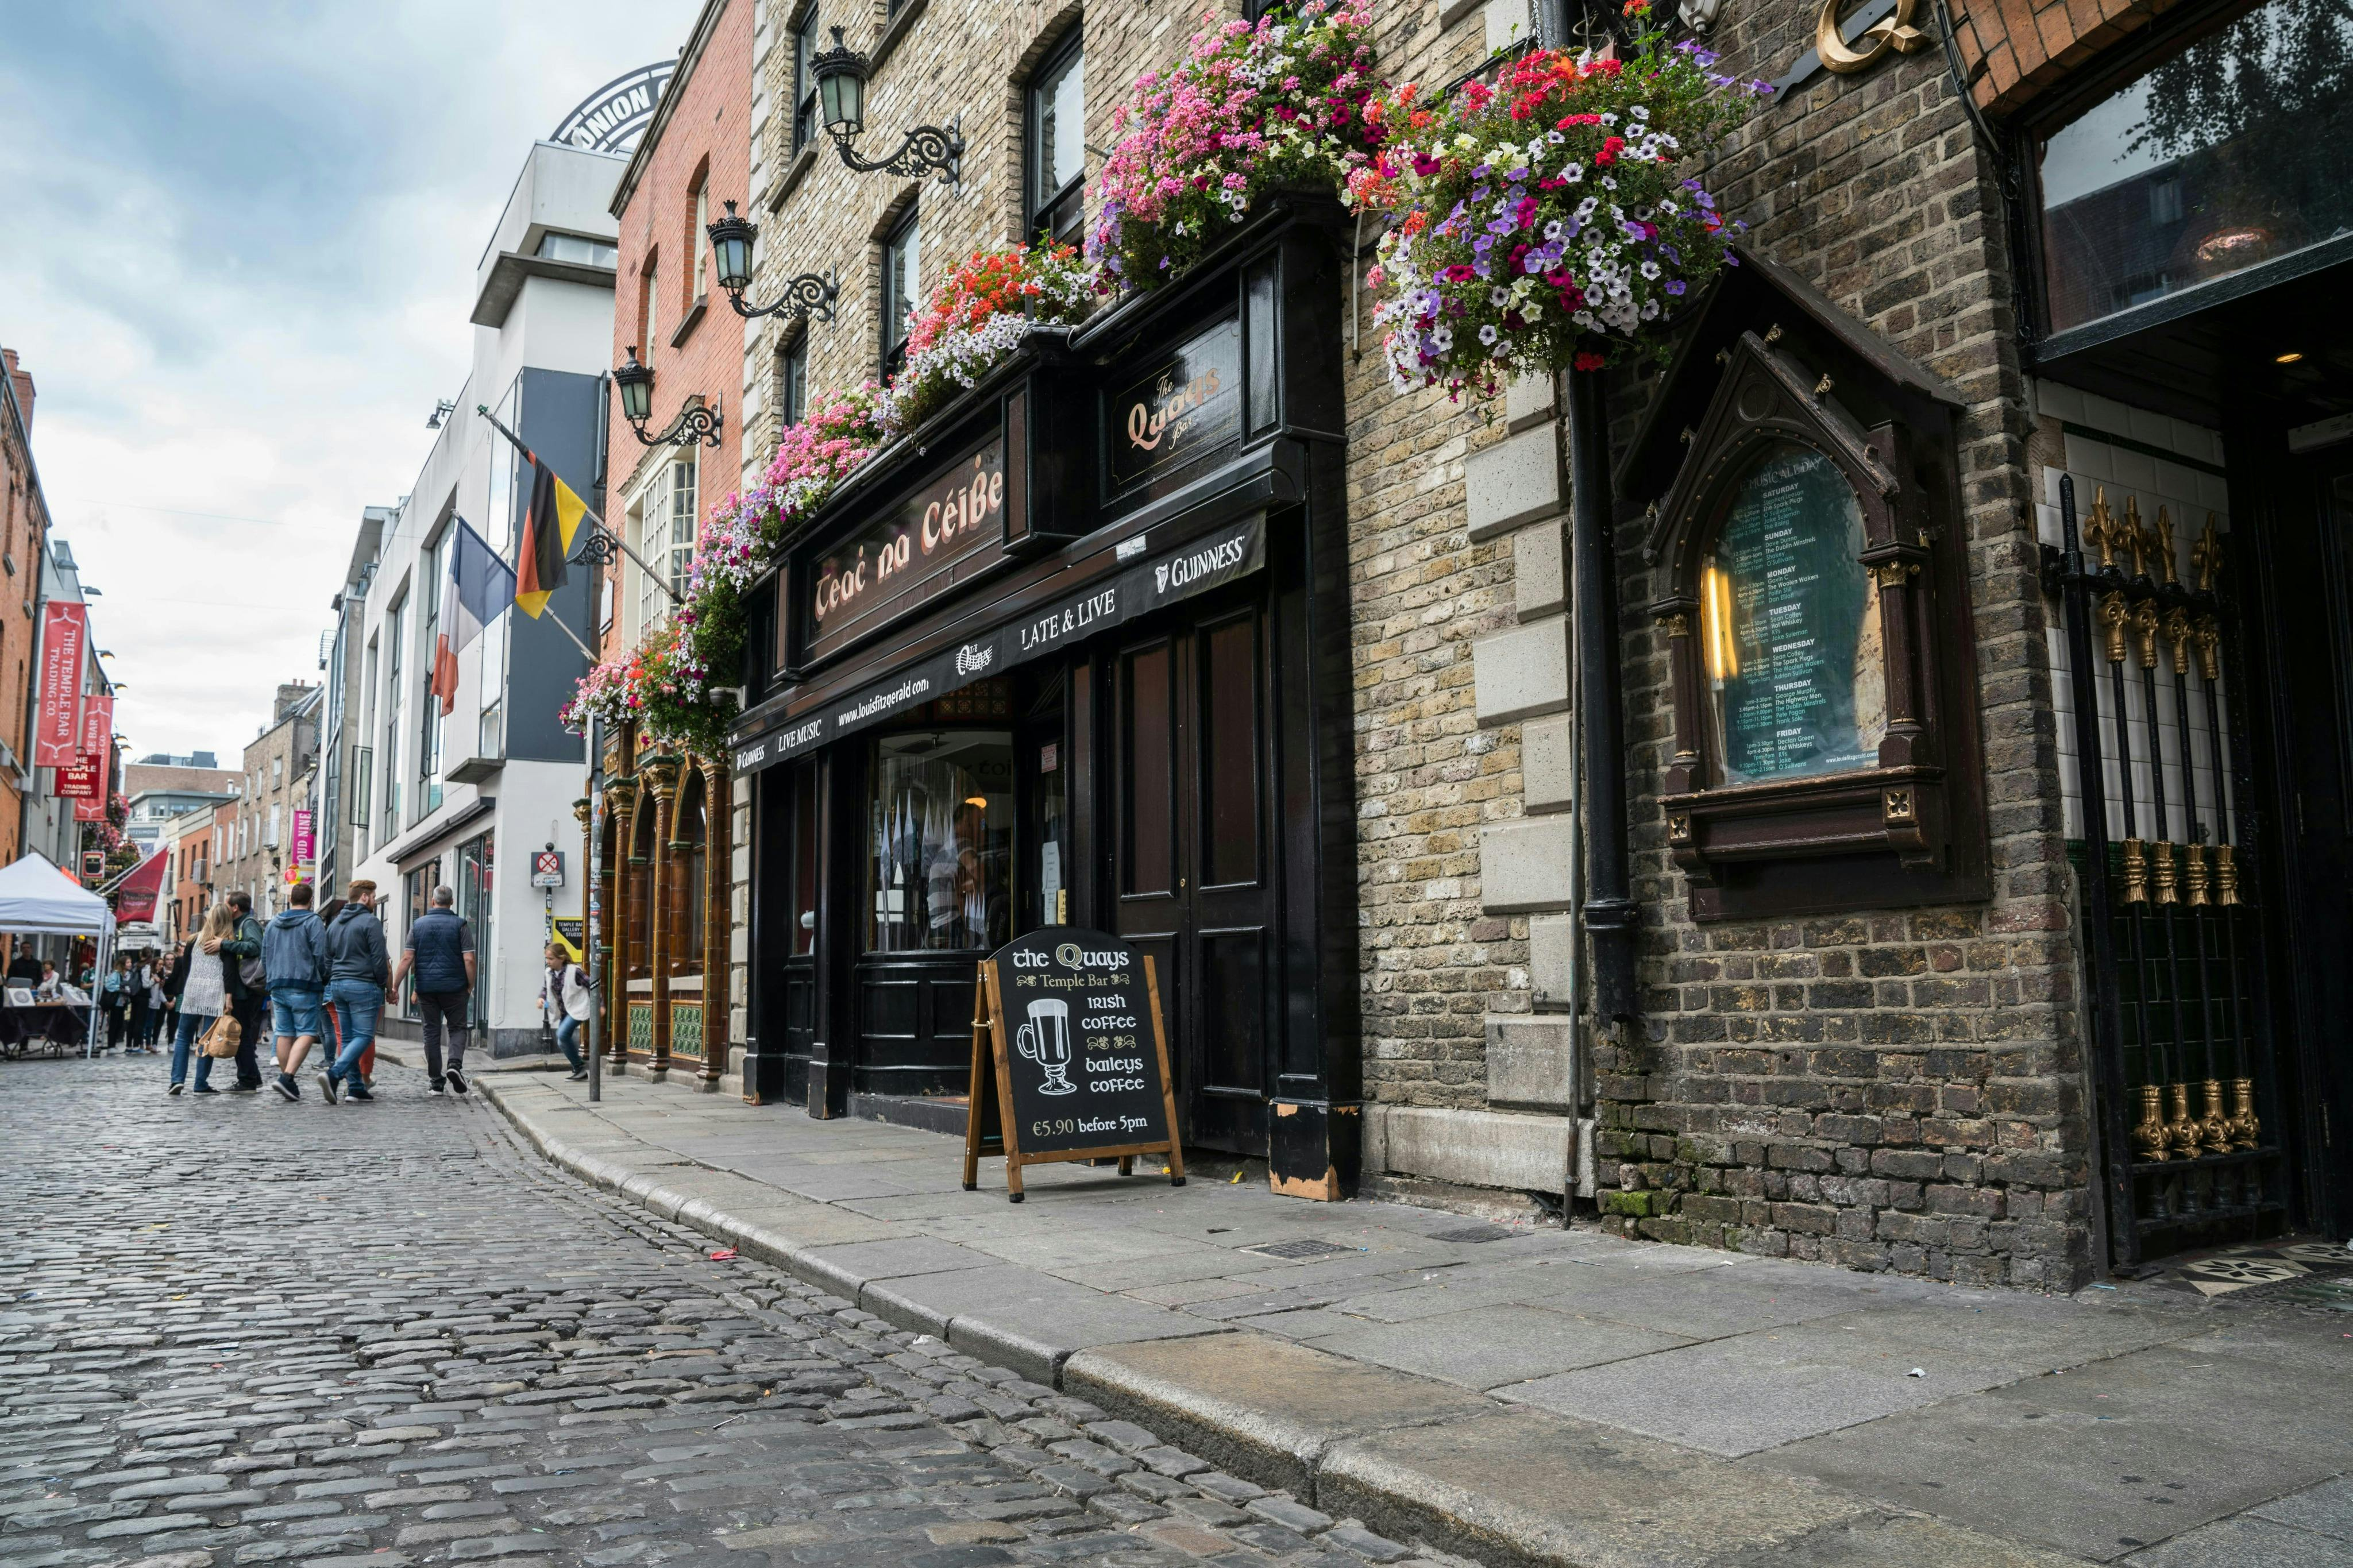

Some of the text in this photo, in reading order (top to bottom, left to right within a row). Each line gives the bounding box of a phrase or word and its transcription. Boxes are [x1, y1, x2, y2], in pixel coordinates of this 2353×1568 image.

[577, 85, 651, 149] UNION
[1154, 369, 1174, 406] The
[1128, 368, 1220, 450] Quays
[1168, 417, 1197, 450] Bar
[1749, 471, 1779, 489] MUSIC
[1781, 465, 1800, 479] ALL
[1801, 457, 1825, 472] DAY
[1762, 482, 1799, 499] SATURDAY
[1763, 495, 1784, 506] Stephen
[1773, 500, 1788, 510] Spark
[1789, 496, 1803, 505] Plugs
[1764, 516, 1776, 524] Jake
[1775, 519, 1789, 527] Rising
[1764, 528, 1792, 541] SUNDAY
[1780, 535, 1797, 544] Dunne
[1776, 542, 1792, 551] Dublin
[1793, 536, 1816, 547] Minstrels
[878, 534, 910, 584] na
[1171, 536, 1244, 588] GUINNESS
[1766, 551, 1785, 561] Shakey
[1767, 565, 1796, 578] MONDAY
[1768, 576, 1783, 584] Gavin
[1778, 579, 1798, 588] Woolen
[1799, 574, 1819, 583] Wakers
[1769, 603, 1802, 616] TUESDAY
[1021, 588, 1116, 651] LATE & LIVE
[1781, 617, 1803, 627] Whiskey
[1785, 628, 1808, 638] Suleman
[1772, 638, 1815, 653] WEDNESDAY
[1787, 650, 1804, 658] Coffey
[1783, 657, 1798, 666] Spark
[1783, 663, 1803, 671] Woolen
[1804, 659, 1824, 667] Wakers
[48, 647, 60, 699] TRADING
[1774, 671, 1791, 680] Adrian
[1792, 668, 1812, 677] Sullivan
[57, 629, 76, 737] THE TEMPLE BAR
[1775, 679, 1811, 692] THURSDAY
[1775, 691, 1795, 700] George
[1796, 687, 1816, 696] Murphy
[1785, 694, 1808, 704] Highway
[838, 678, 929, 727] www.louisfitzgeraldcom
[1785, 702, 1802, 710] Dublin
[1803, 698, 1826, 706] Minstrels
[1789, 709, 1806, 717] Fagan
[89, 720, 98, 738] BAR
[778, 719, 822, 752] LIVE MUSIC
[1777, 727, 1802, 737] FRIDAY
[1746, 740, 1774, 750] 1pm-3.30pm
[1777, 737, 1796, 746] Declan
[1747, 747, 1775, 756] 4pm-6.30pm
[1788, 741, 1812, 750] Whiskeys
[742, 745, 765, 768] GUINNESS
[1753, 753, 1775, 761] 7pm-9pm
[298, 813, 312, 837] NINE
[1056, 943, 1130, 971] Quays
[1039, 971, 1108, 991] Temple Bar
[1032, 1115, 1148, 1137] €5.90 before 5pm
